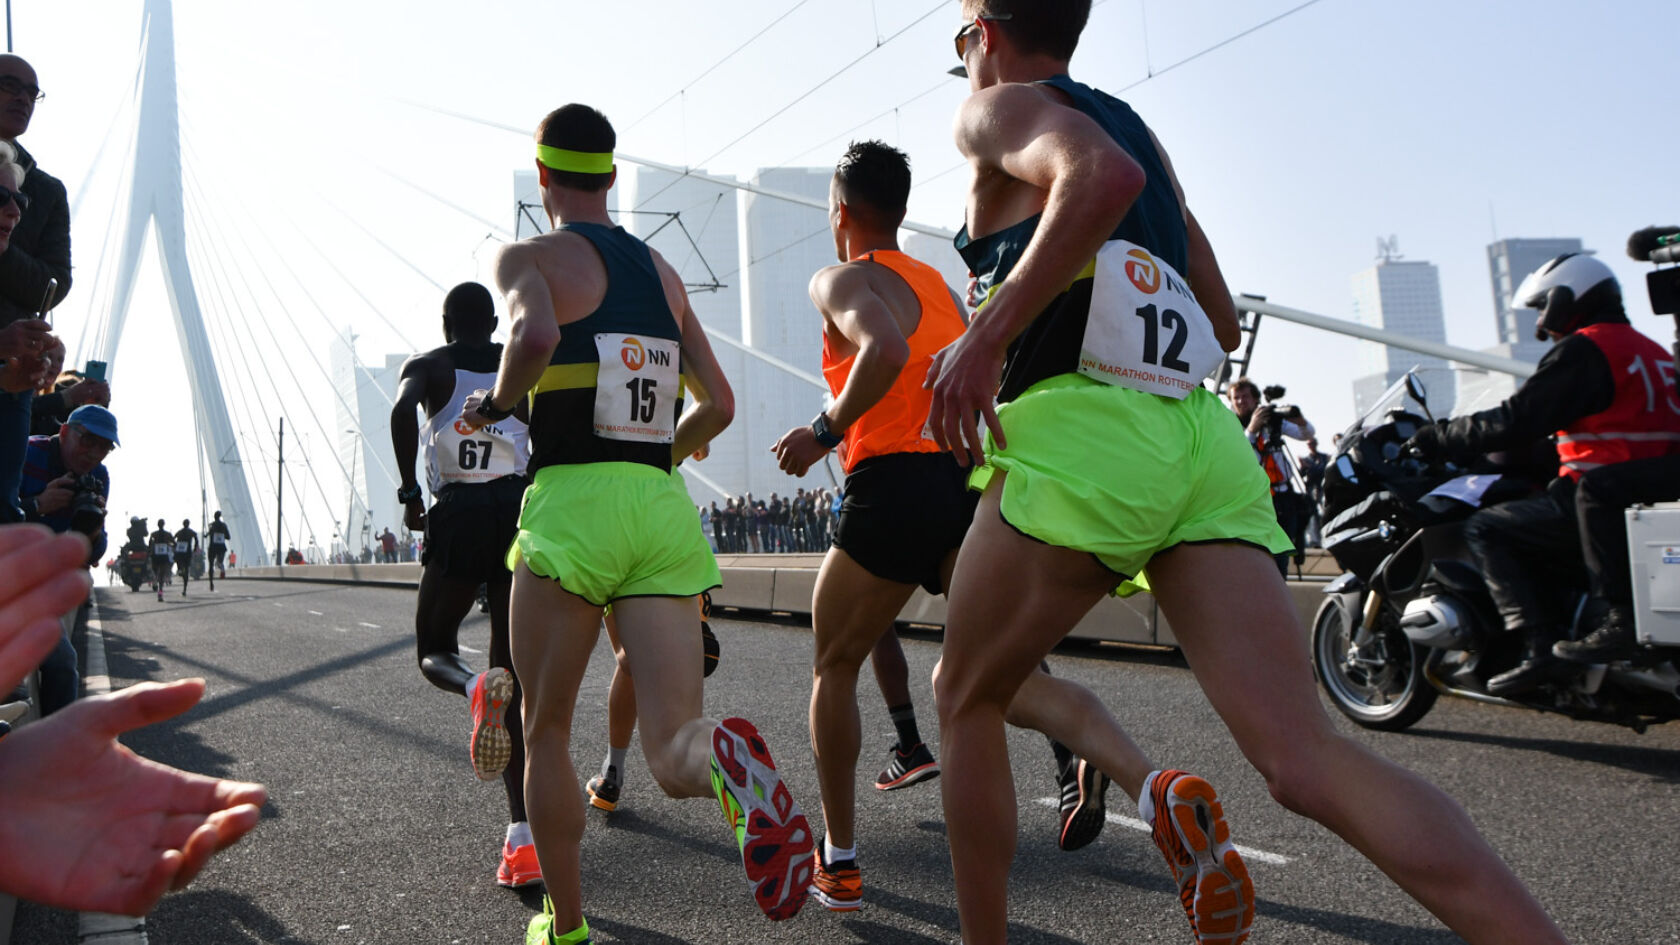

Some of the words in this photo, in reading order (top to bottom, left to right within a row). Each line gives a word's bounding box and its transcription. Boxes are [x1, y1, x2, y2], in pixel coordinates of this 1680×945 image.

[1164, 270, 1196, 304] NN
[1135, 303, 1190, 374] 12
[647, 348, 670, 367] NN
[1081, 359, 1096, 369] NN
[1098, 363, 1156, 383] MARATHON
[625, 377, 657, 423] 15
[481, 424, 503, 435] NN
[458, 439, 493, 470] 67
